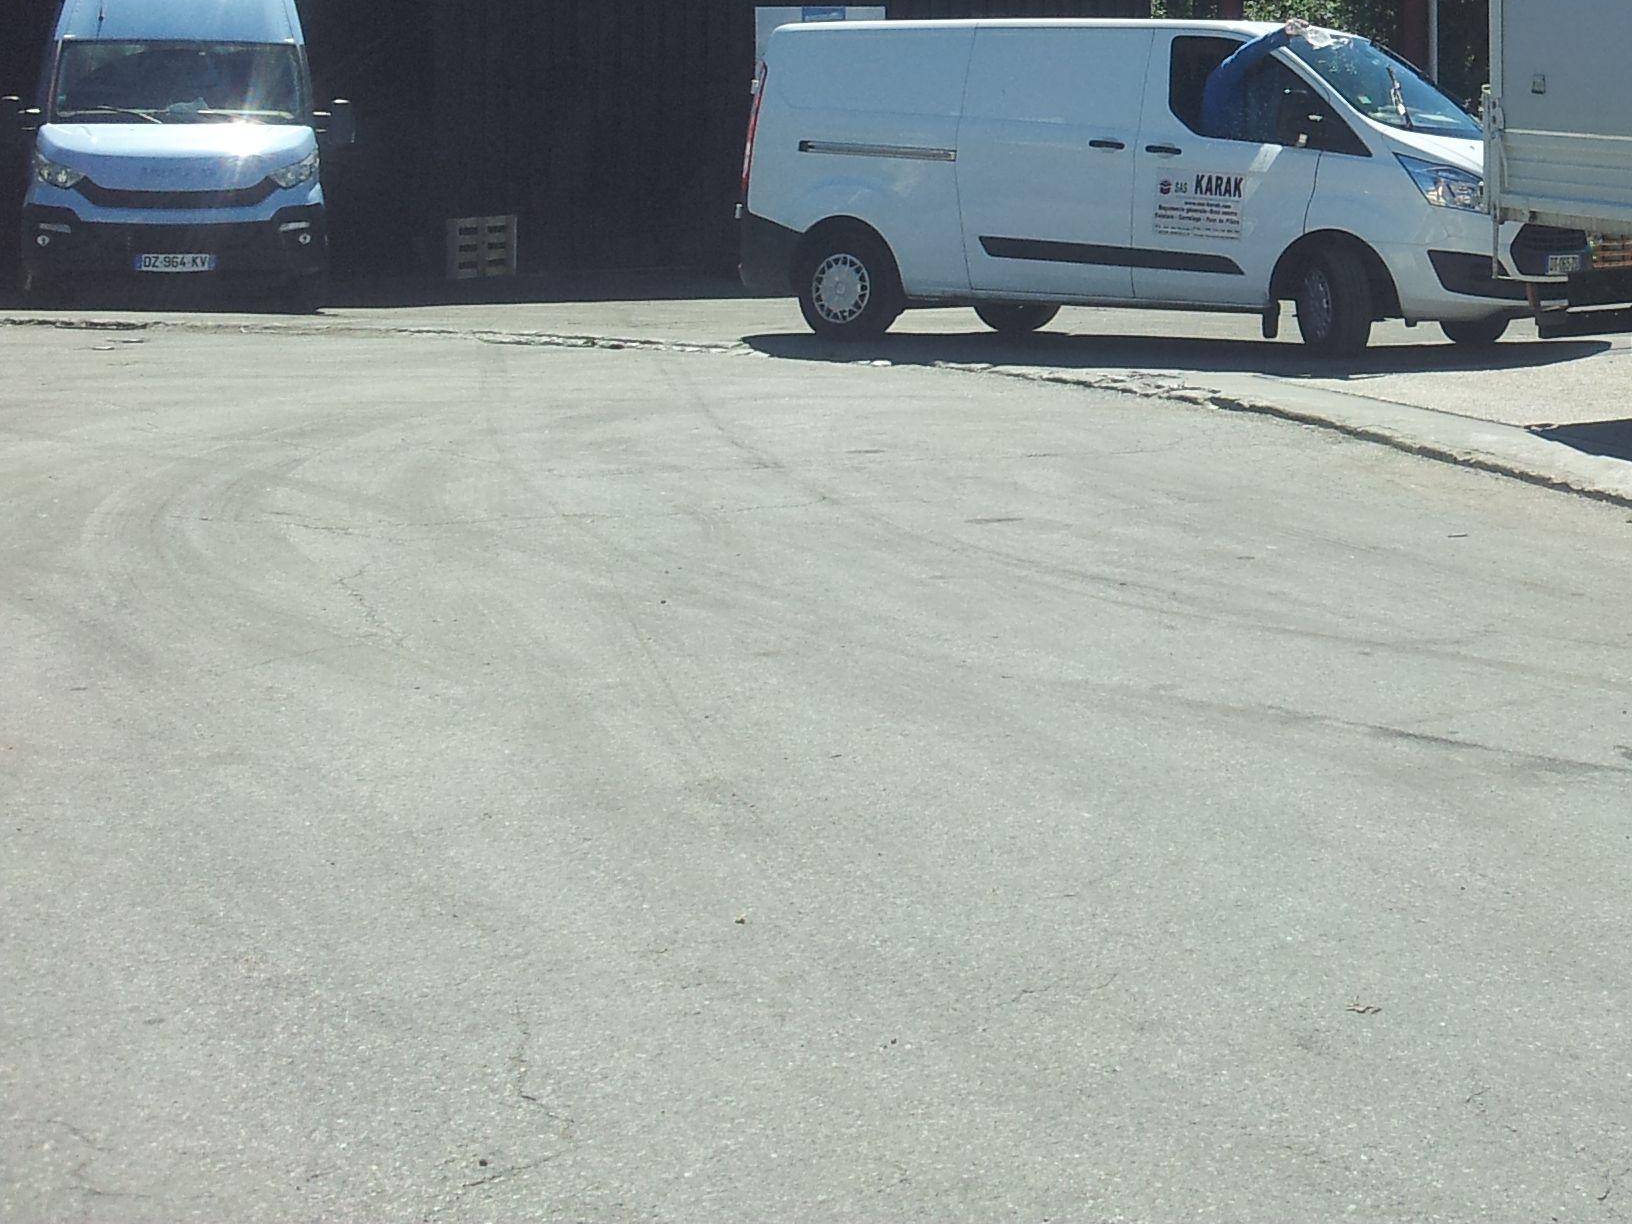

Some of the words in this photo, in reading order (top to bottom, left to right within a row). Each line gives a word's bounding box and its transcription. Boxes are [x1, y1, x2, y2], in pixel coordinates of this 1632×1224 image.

[1174, 181, 1188, 193] SAS
[1194, 174, 1243, 198] KARAK
[143, 256, 208, 268] DZ-964-KV
